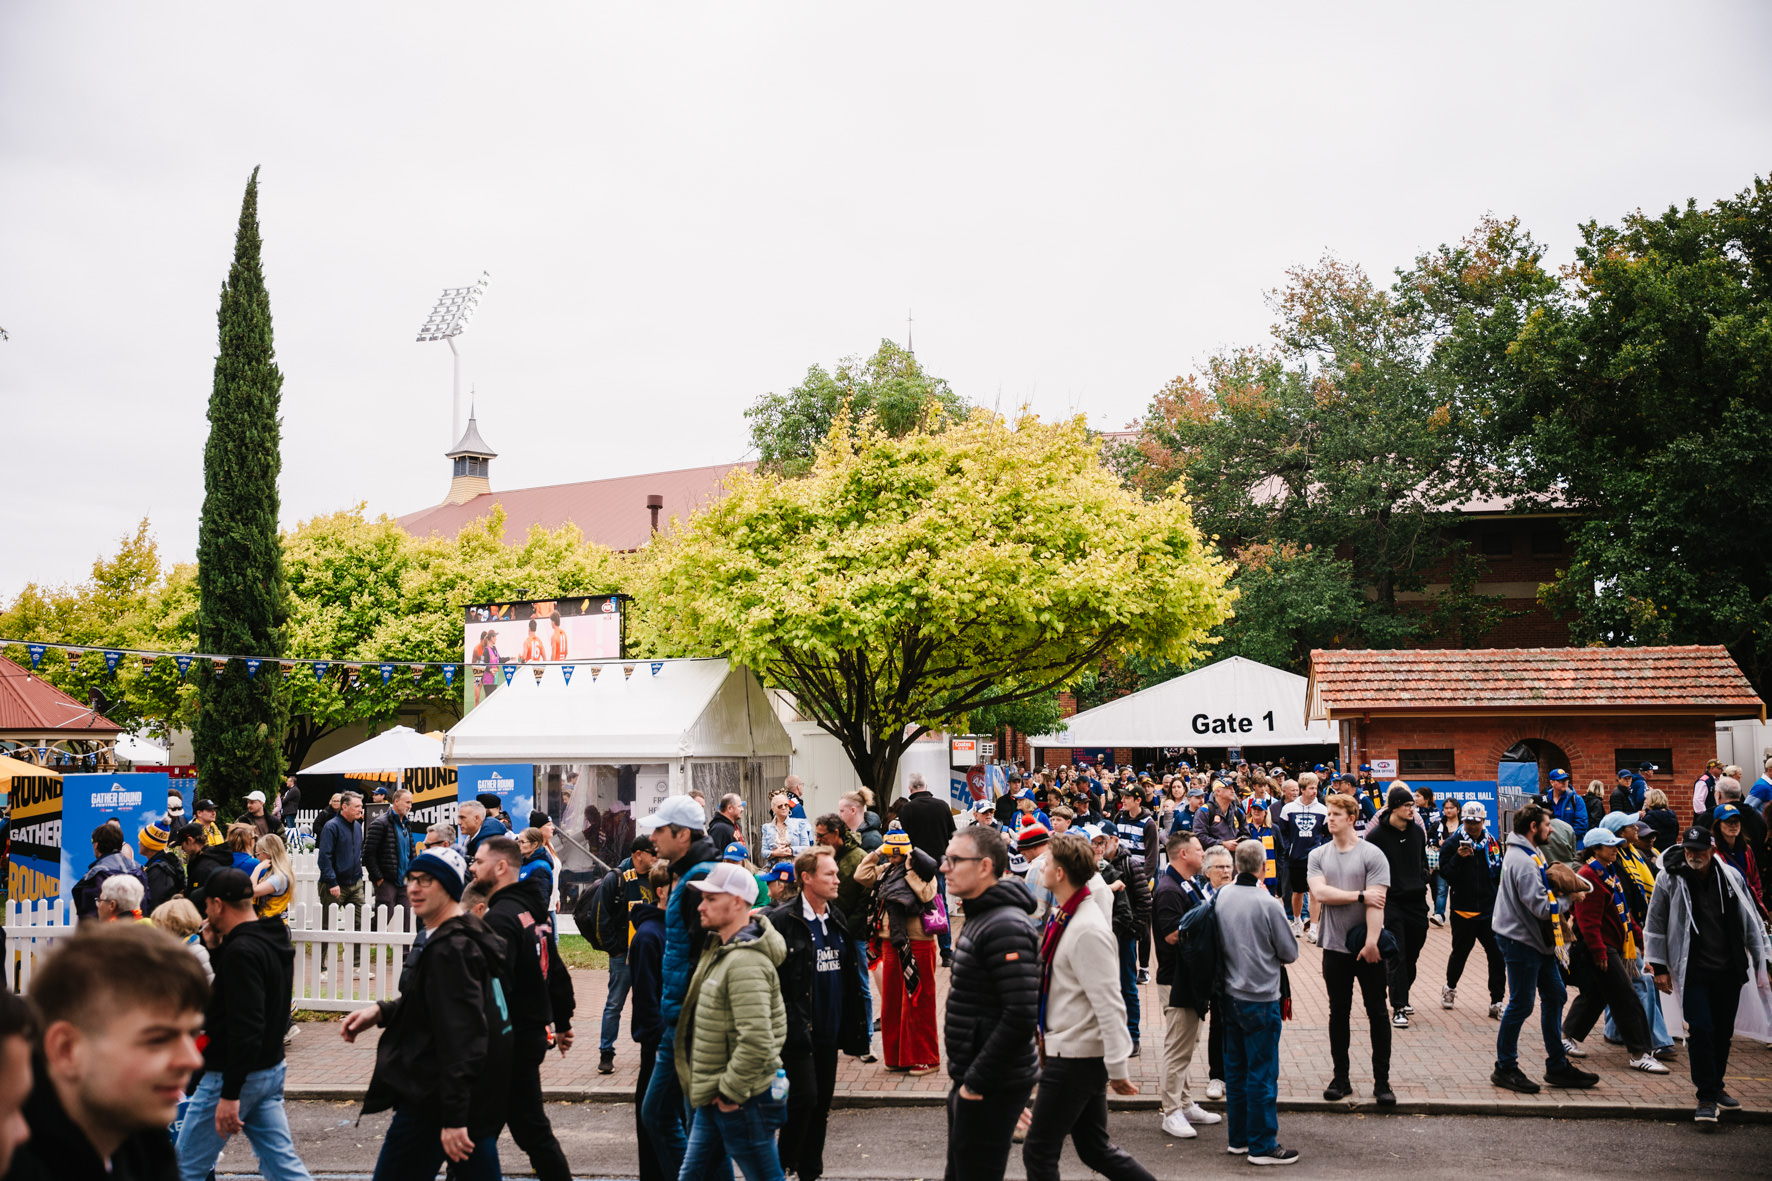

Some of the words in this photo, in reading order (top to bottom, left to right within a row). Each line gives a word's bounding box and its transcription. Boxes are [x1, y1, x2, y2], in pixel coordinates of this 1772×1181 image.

[531, 640, 541, 659] 16
[1192, 713, 1253, 734] Gate
[1263, 710, 1274, 731] 1
[404, 766, 458, 794] ROUND
[477, 779, 497, 789] GATHER
[497, 779, 514, 789] ROUND
[11, 776, 63, 810] ROUND
[91, 792, 118, 804] GATHER
[118, 791, 142, 803] ROUND
[1433, 791, 1445, 801] TED
[1453, 792, 1465, 800] THE
[1465, 792, 1477, 801] RSL
[1478, 791, 1495, 800] HALL.
[406, 801, 459, 826] GATHER
[10, 819, 62, 848] GATHER
[8, 861, 60, 905] ROUND
